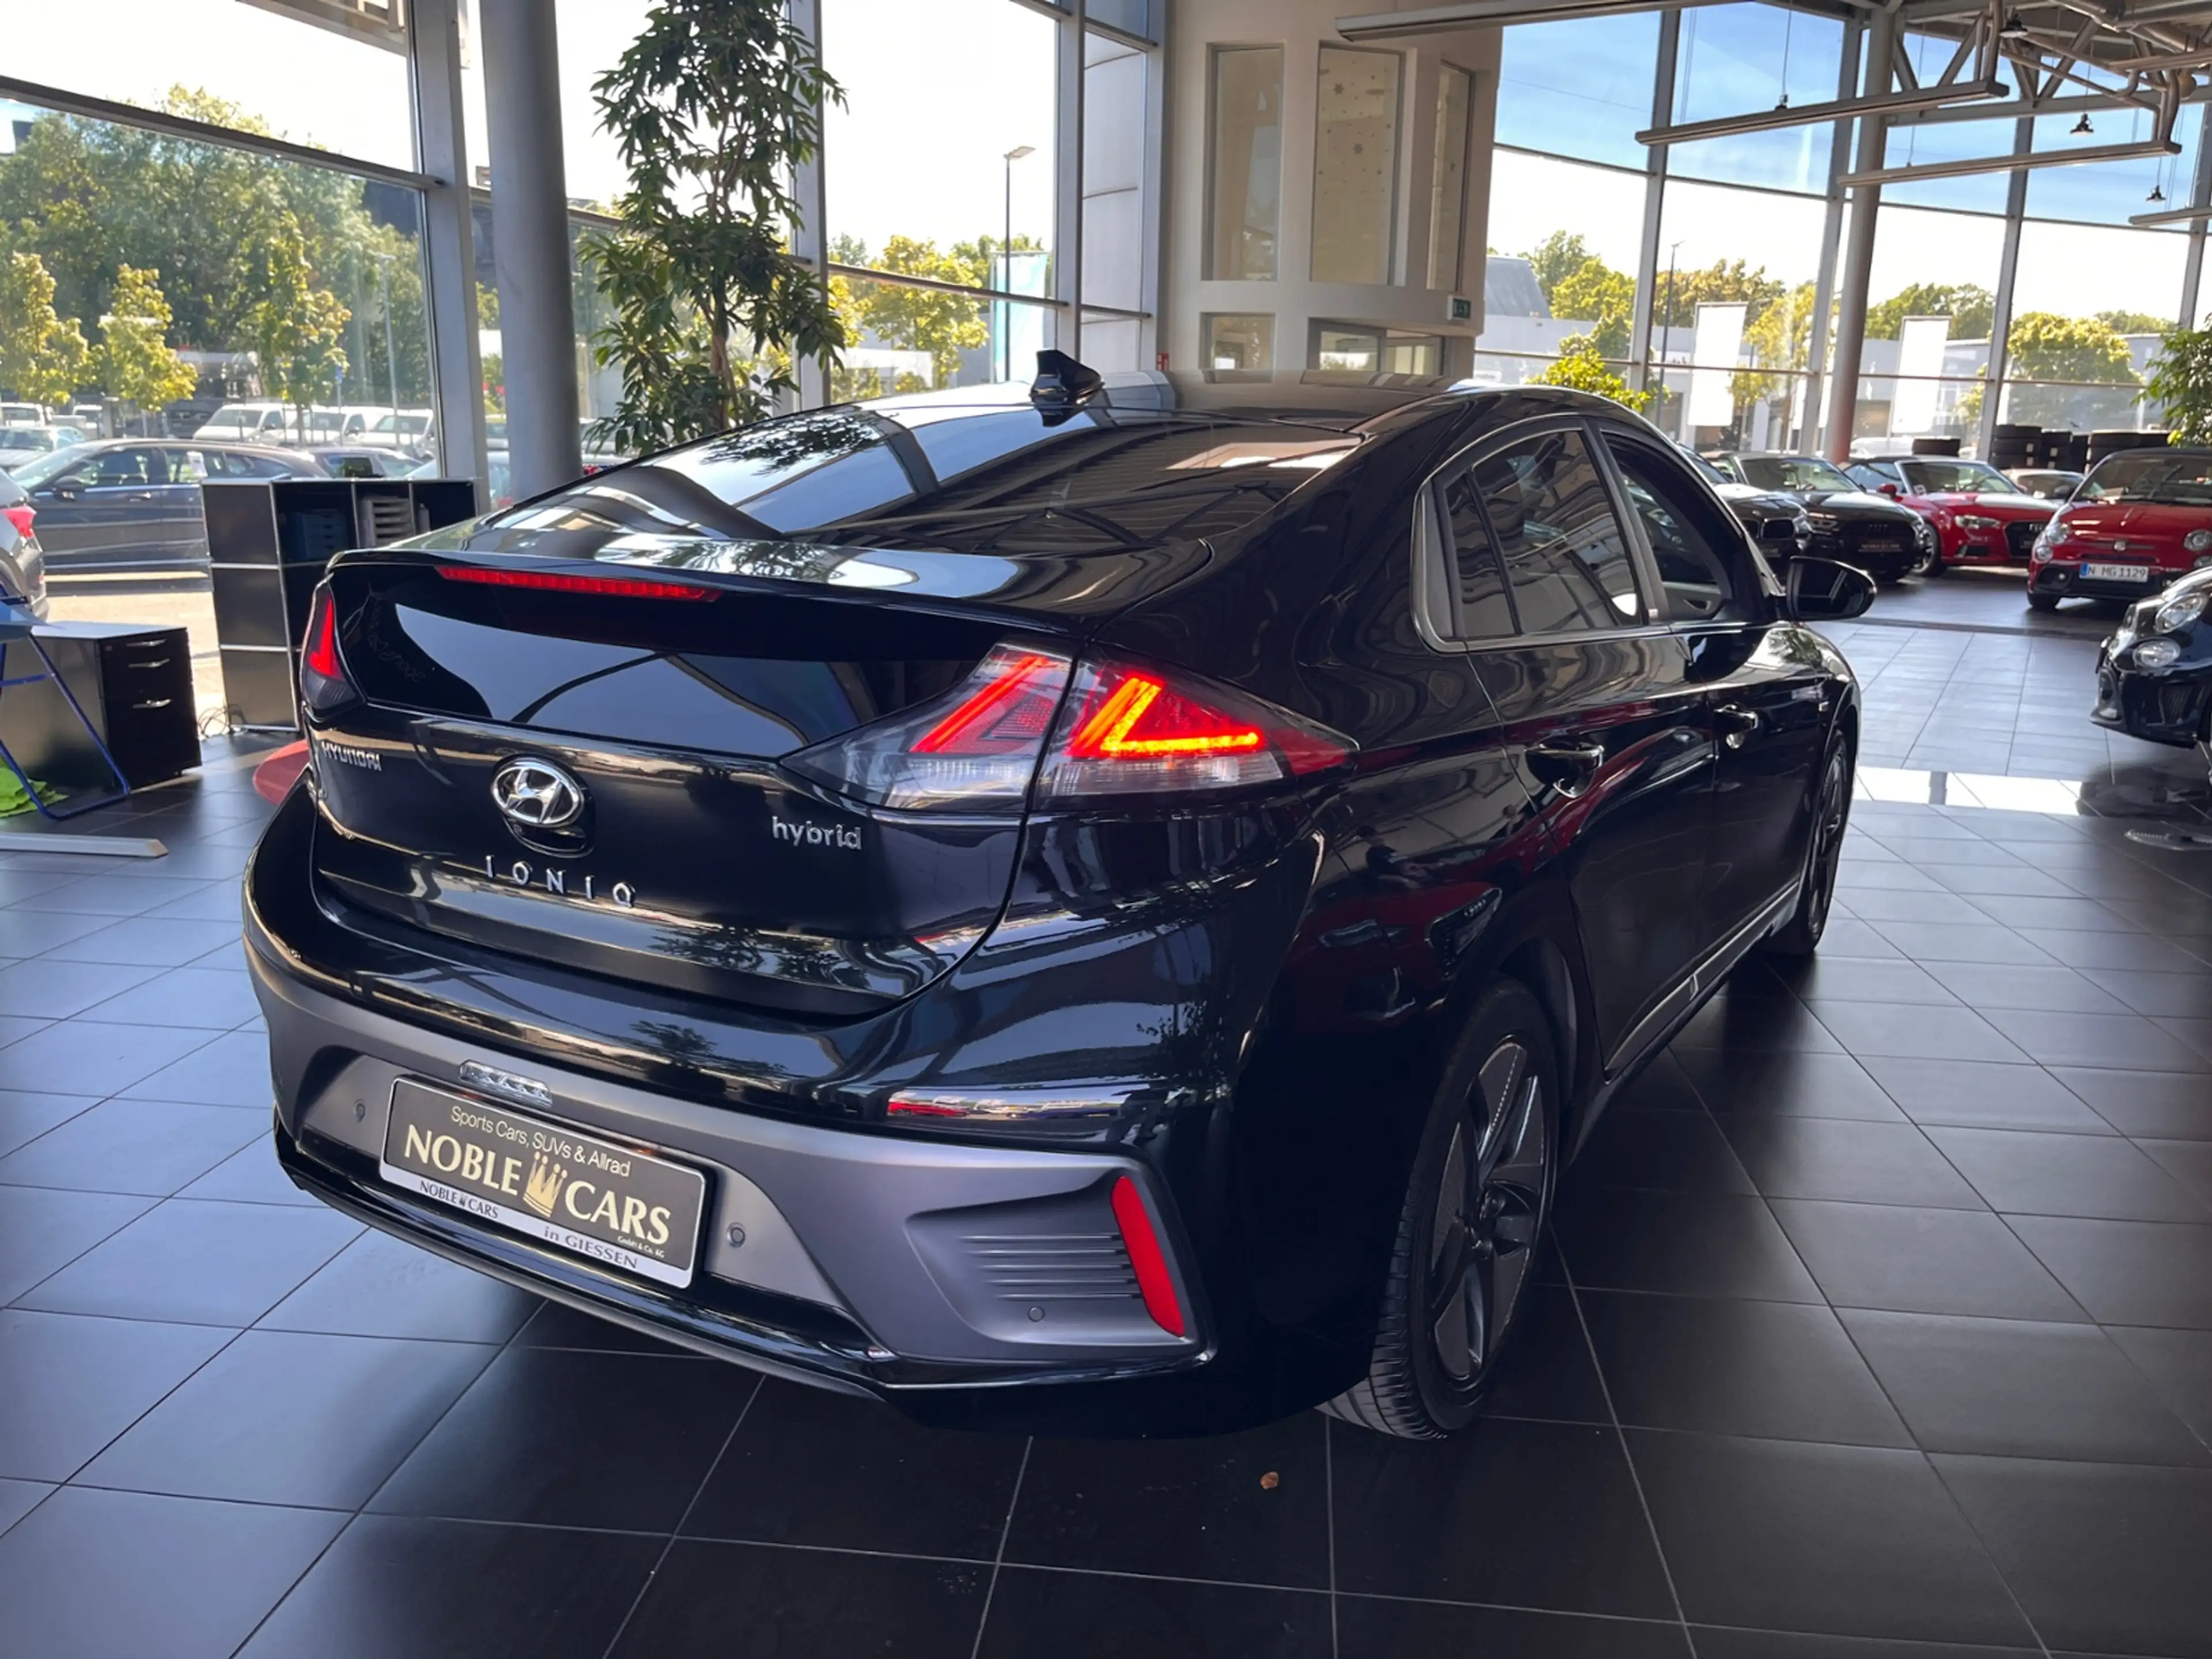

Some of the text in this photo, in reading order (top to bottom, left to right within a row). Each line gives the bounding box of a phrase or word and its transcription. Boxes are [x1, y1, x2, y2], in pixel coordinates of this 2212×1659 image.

[321, 741, 382, 771] HYUNDAI
[772, 816, 862, 850] hybrid
[485, 854, 636, 908] IONIQ
[451, 1106, 631, 1177] Sports Cars, SUVs & Allrad
[404, 1124, 672, 1245] NOBLE CARS
[420, 1181, 499, 1218] NOBLE CARS
[544, 1226, 638, 1268] in GIESSEN
